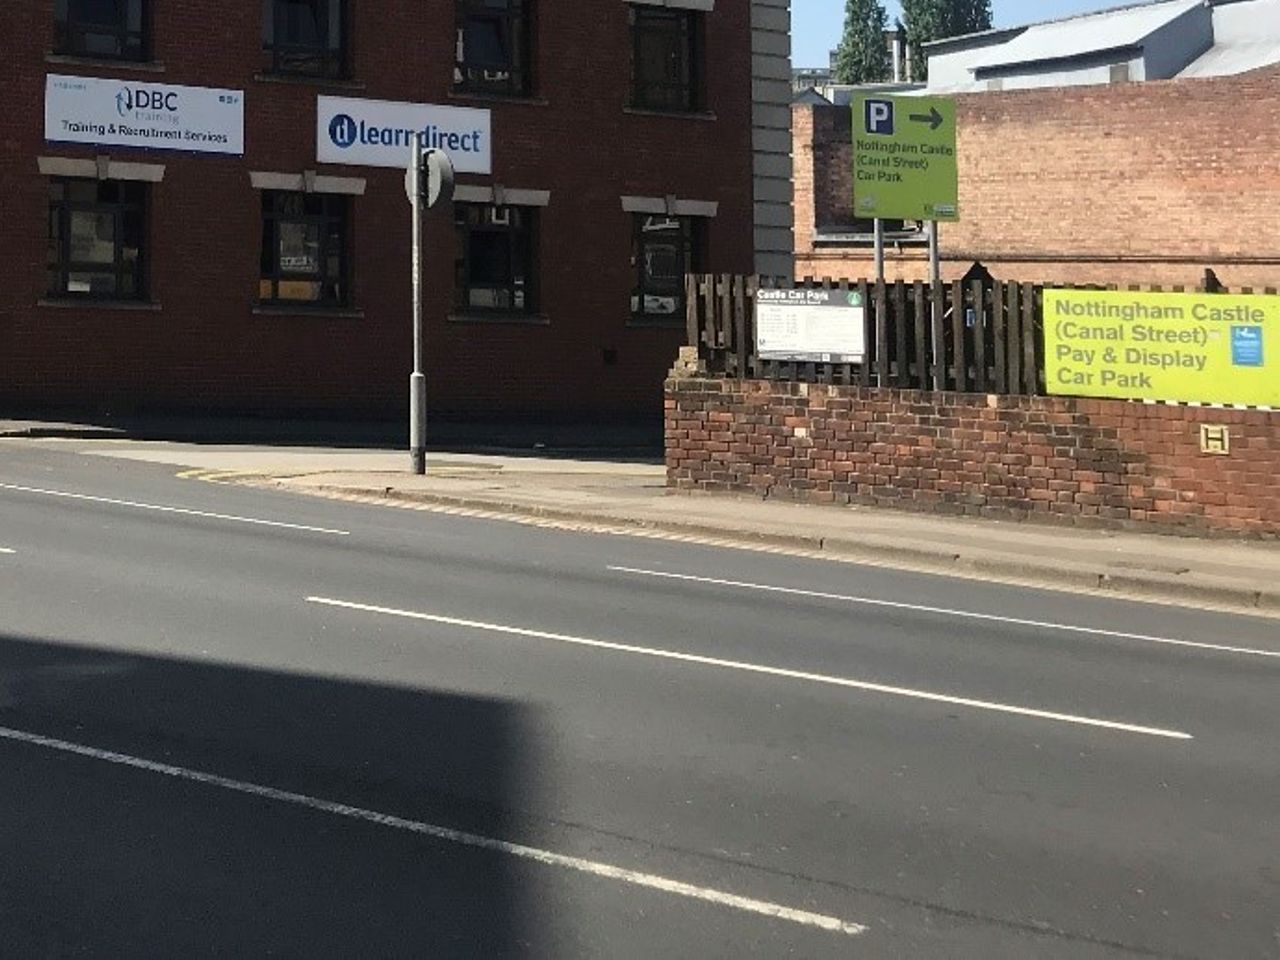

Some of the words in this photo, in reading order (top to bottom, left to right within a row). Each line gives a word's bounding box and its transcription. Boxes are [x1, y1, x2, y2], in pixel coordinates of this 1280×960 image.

[135, 90, 178, 111] DBC
[135, 111, 180, 125] training
[870, 103, 888, 131] P
[61, 119, 105, 135] Training
[108, 123, 116, 134] &
[119, 125, 181, 140] Recruitment
[184, 131, 228, 143] Services
[856, 140, 918, 154] Nottingham
[920, 144, 953, 156] Castle
[856, 154, 890, 167] (Canal
[893, 157, 929, 171] Street)
[857, 170, 875, 181] Car
[877, 171, 902, 182] Park
[757, 289, 786, 299] Castle
[788, 290, 805, 299] Car
[807, 290, 829, 300] Park
[1055, 299, 1184, 321] Nottingham
[1191, 303, 1265, 323] Castle
[1055, 321, 1124, 341] (Canal
[1131, 324, 1208, 346] Street)
[1056, 344, 1095, 366] Pay
[1102, 346, 1118, 364] &
[1125, 347, 1207, 371] Display
[1057, 367, 1095, 385] Car
[1101, 369, 1153, 389] Park
[1204, 427, 1226, 451] H
